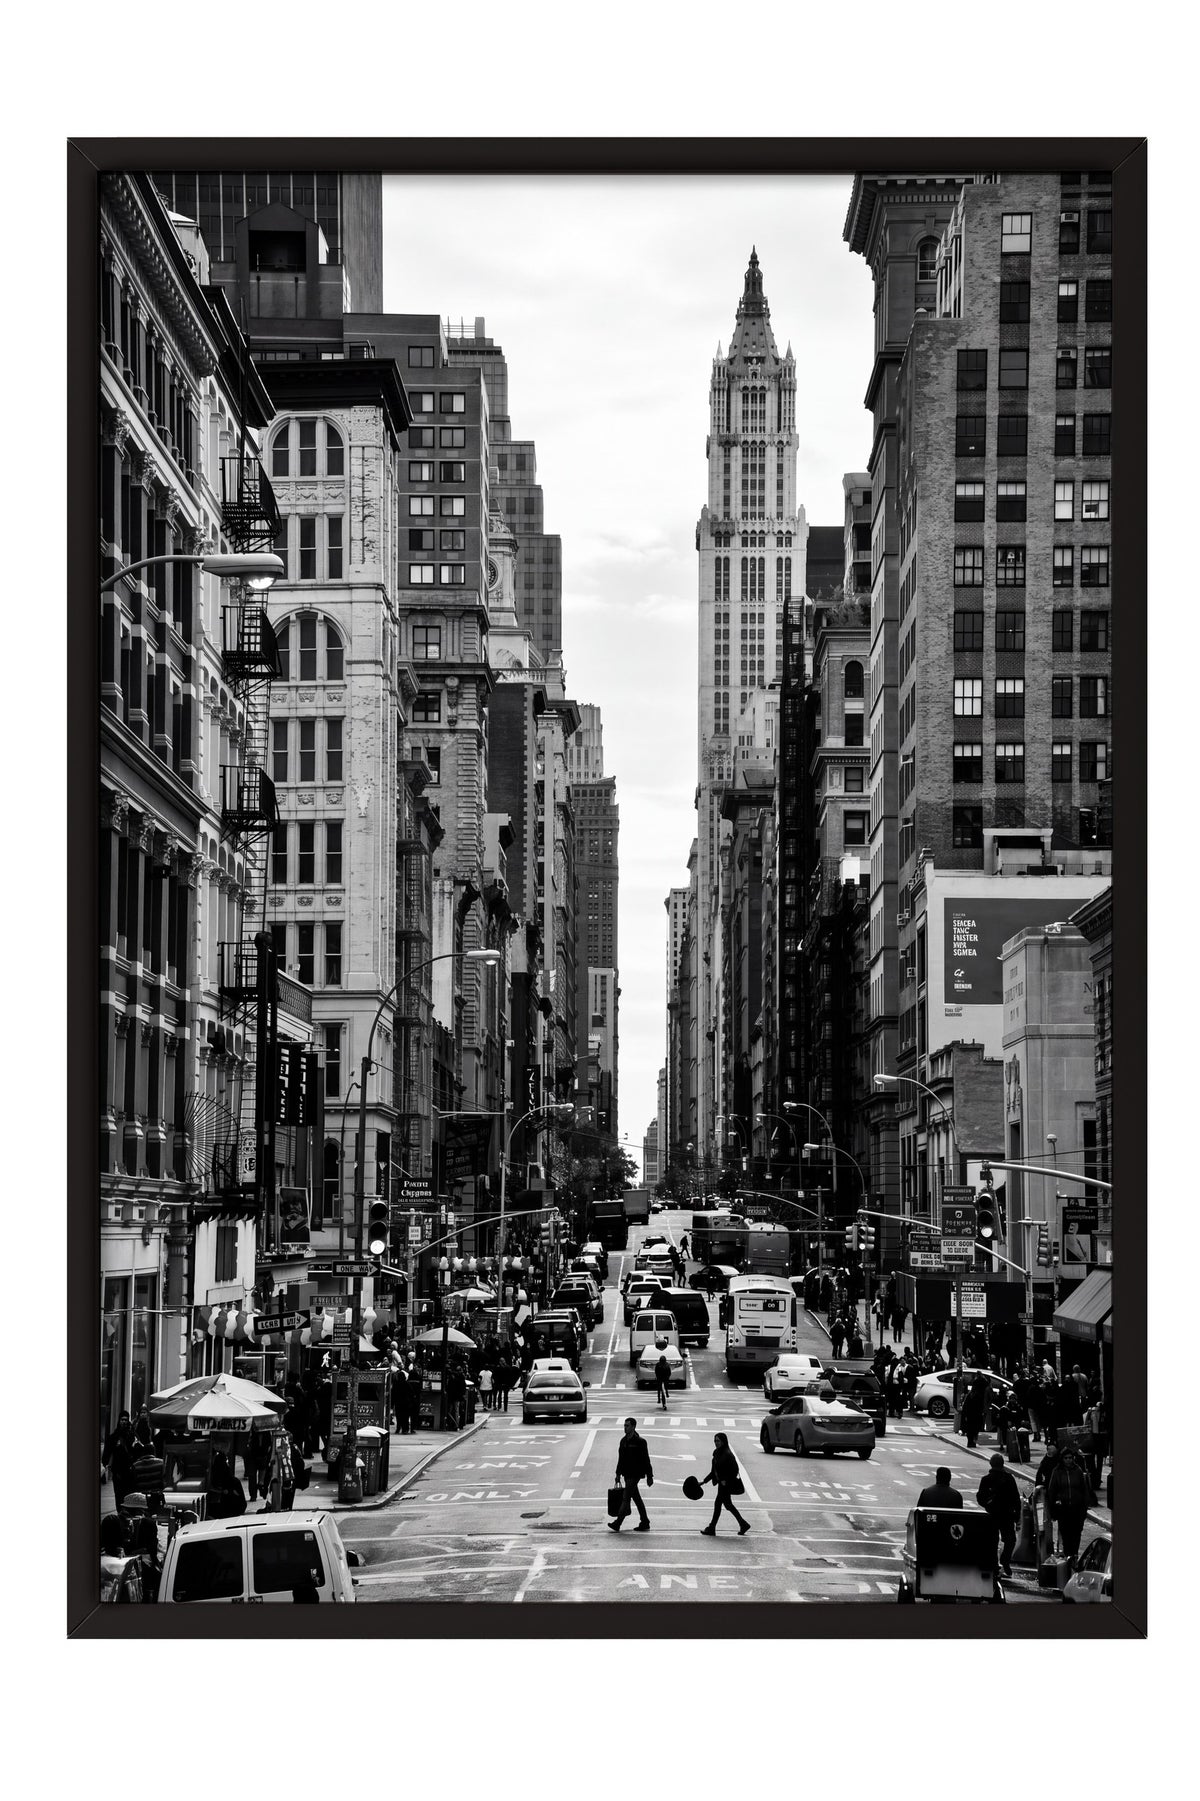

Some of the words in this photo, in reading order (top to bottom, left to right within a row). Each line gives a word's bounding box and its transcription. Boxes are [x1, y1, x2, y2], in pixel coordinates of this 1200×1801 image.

[340, 1264, 354, 1273] ONE
[359, 1264, 374, 1273] WAY
[454, 1460, 551, 1470] ONLY
[778, 1480, 875, 1490] ONLY
[425, 1489, 539, 1501] ONLY
[788, 1490, 878, 1502] BUS
